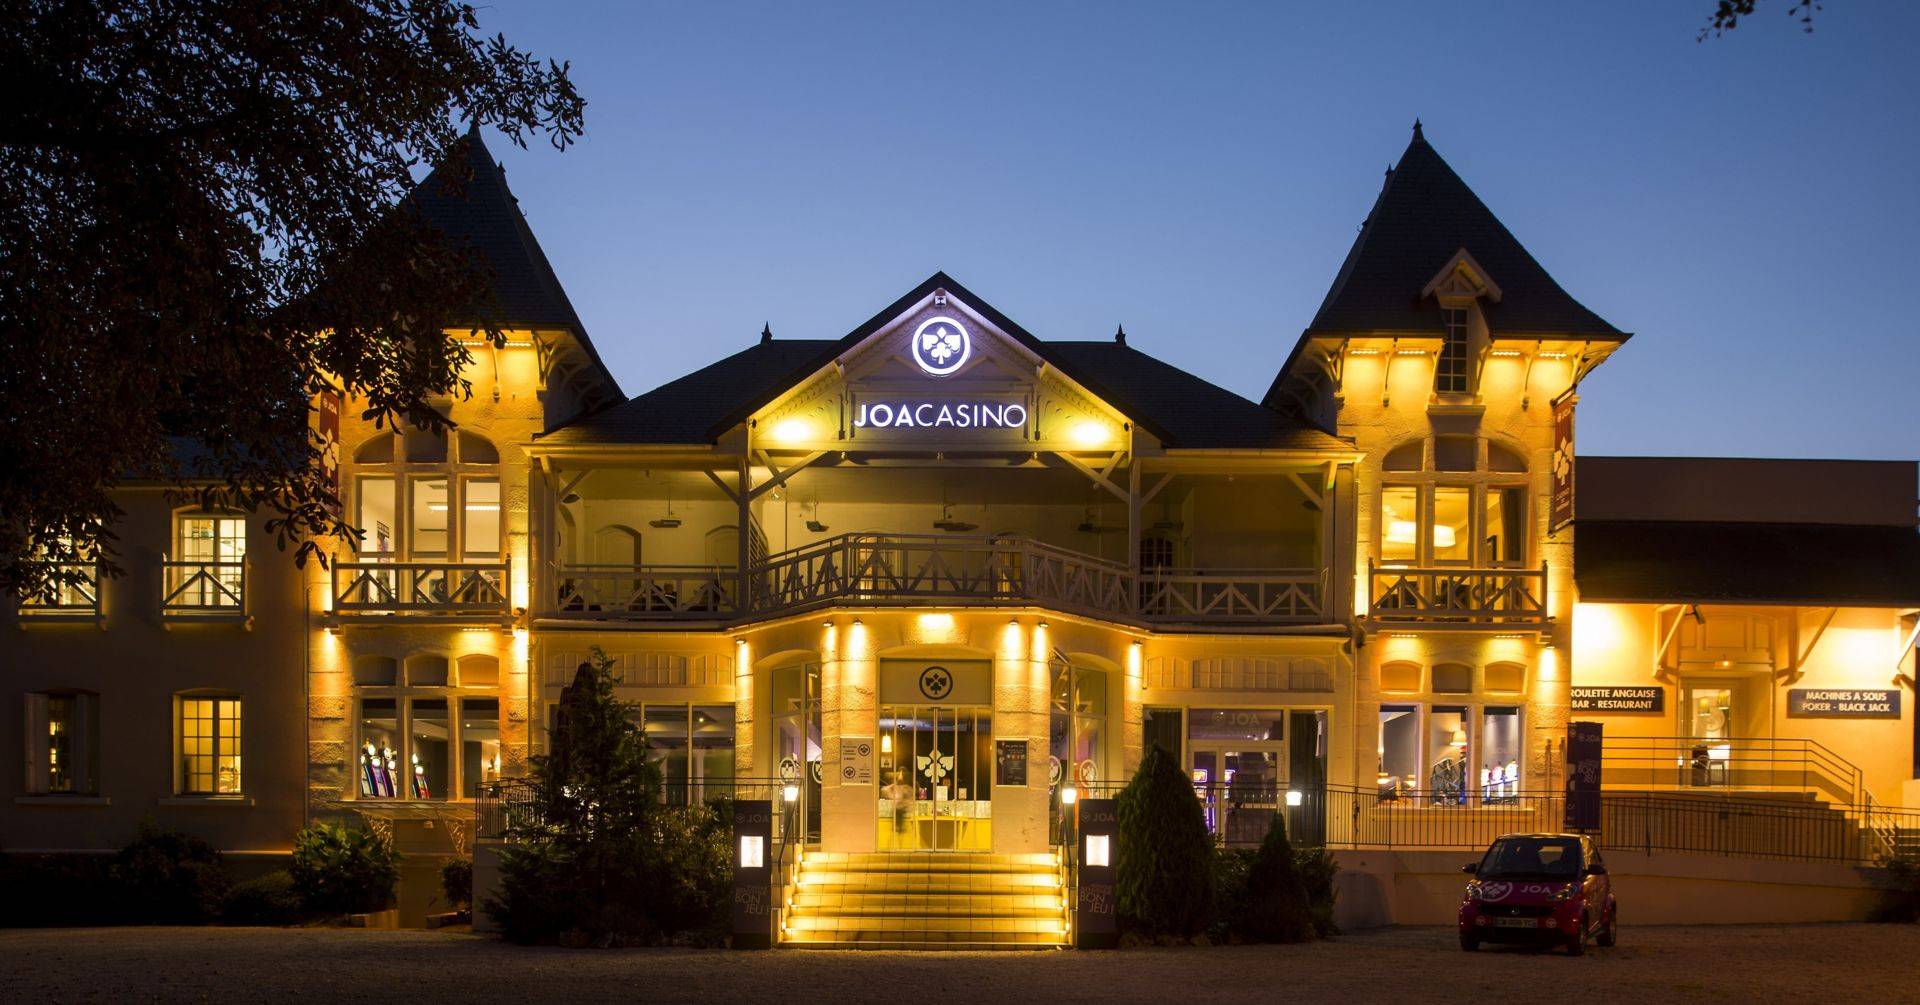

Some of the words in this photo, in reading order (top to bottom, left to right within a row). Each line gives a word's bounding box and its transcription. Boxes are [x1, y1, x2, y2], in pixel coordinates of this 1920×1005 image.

[854, 404, 1027, 427] JOACASINO
[1612, 689, 1656, 698] ANGLAISE
[1806, 691, 1851, 700] MACHINES
[1853, 692, 1861, 700] A
[1862, 692, 1888, 701] SOUS
[1572, 700, 1589, 708] BAR
[1597, 700, 1653, 709] RESTAURANT
[1802, 702, 1831, 711] POKER
[1838, 703, 1865, 711] BLACK
[1867, 703, 1890, 712] JACK
[1228, 712, 1260, 725] JOA
[746, 814, 769, 824] JOA
[1093, 812, 1114, 824] JOA
[1520, 884, 1552, 894] JOA
[1080, 891, 1105, 903] BON
[1088, 902, 1108, 914] JEU
